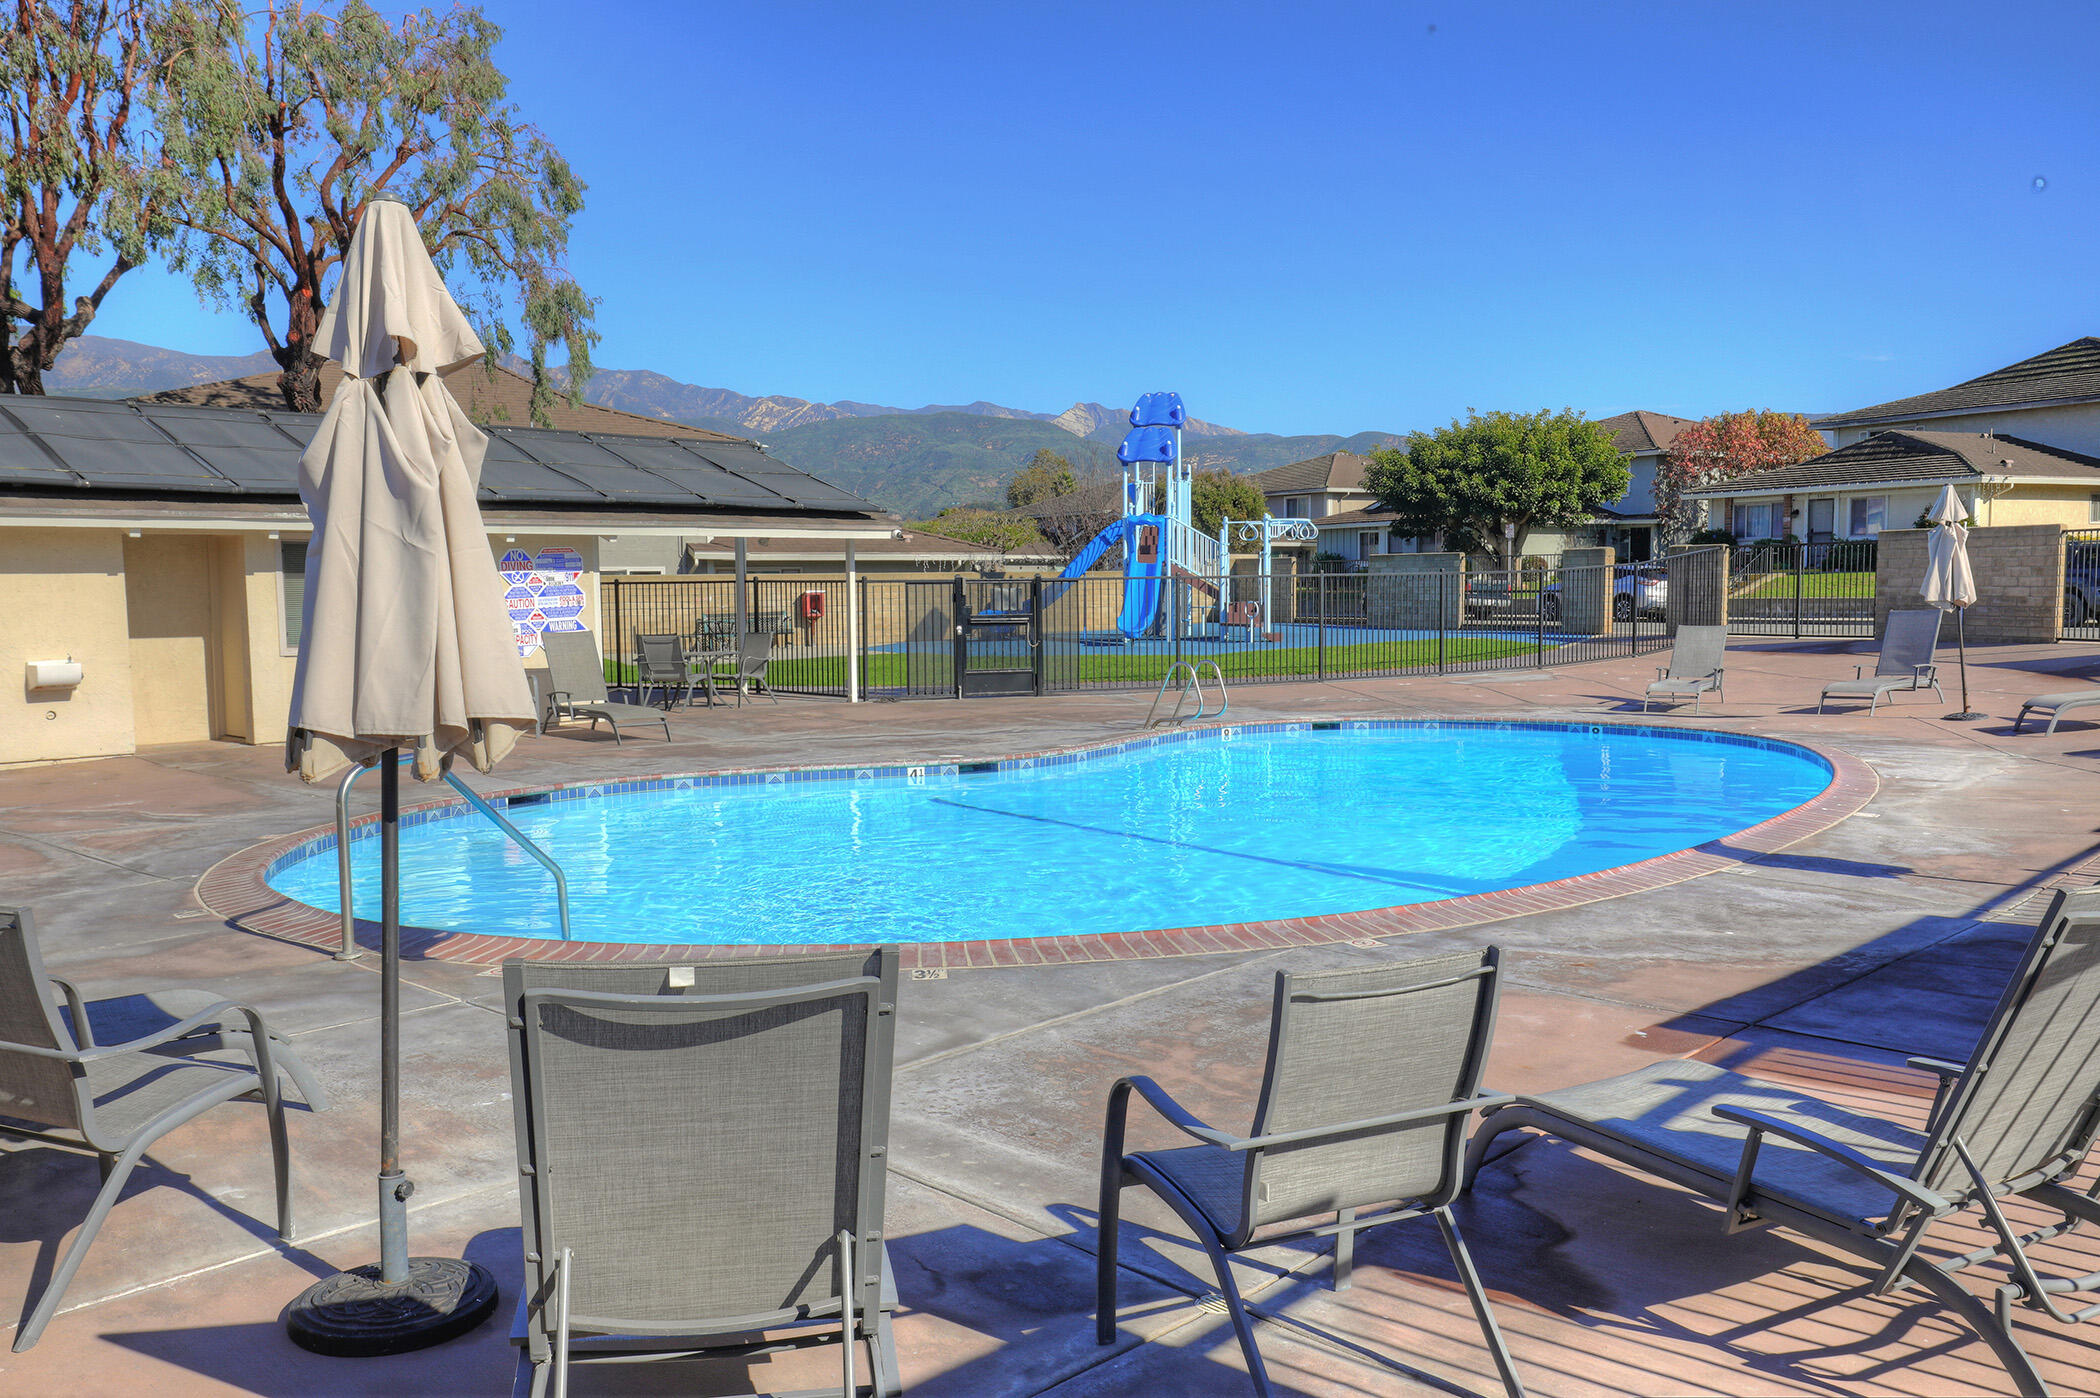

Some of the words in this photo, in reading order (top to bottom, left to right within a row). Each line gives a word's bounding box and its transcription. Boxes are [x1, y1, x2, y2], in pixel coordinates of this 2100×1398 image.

[510, 550, 523, 560] NO
[500, 560, 533, 571] DIVING
[549, 620, 577, 632] WARNING
[514, 633, 538, 645] PACITY
